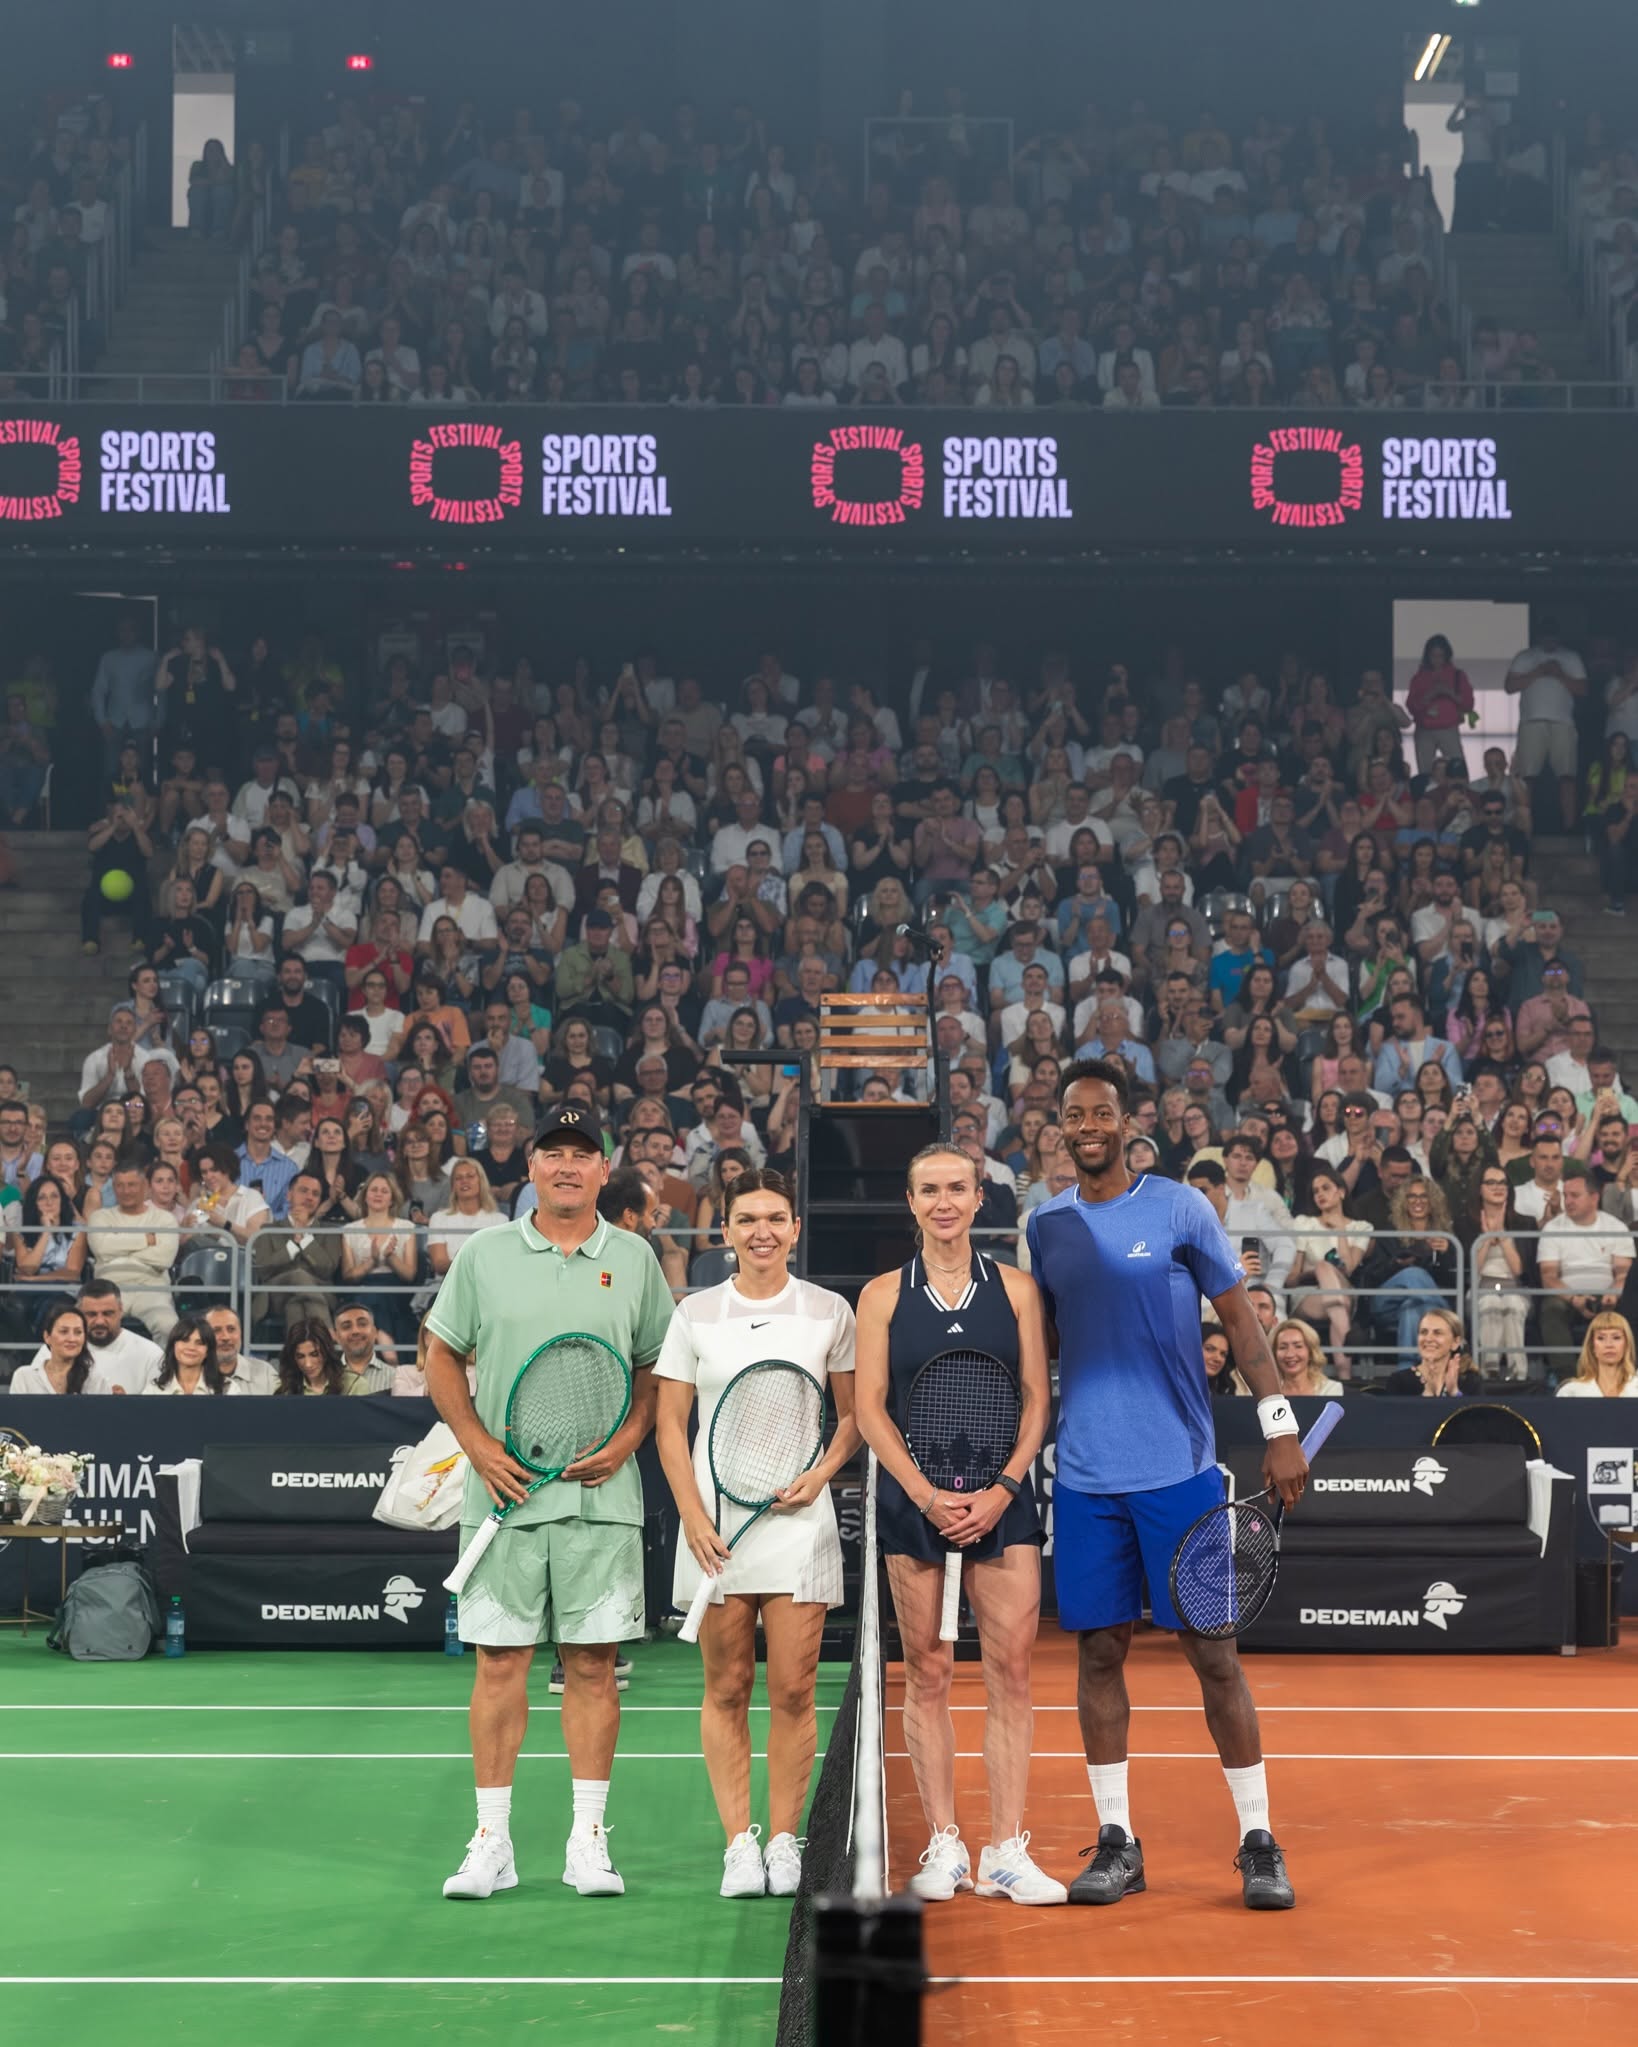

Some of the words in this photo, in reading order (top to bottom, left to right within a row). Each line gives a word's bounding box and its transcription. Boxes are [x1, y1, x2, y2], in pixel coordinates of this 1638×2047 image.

[0, 420, 60, 445] ESTIVAL
[101, 431, 215, 471] SPORTS
[428, 423, 503, 449] FESTIVAL
[830, 425, 904, 451] FESTIVAL
[1269, 427, 1343, 452] FESTIVAL
[57, 436, 81, 503] SPORTS
[409, 439, 434, 506] SPORTS
[498, 441, 523, 506] SPORTS
[542, 434, 656, 474] SPORTS
[943, 436, 1057, 476] SPORTS
[1382, 438, 1497, 477] SPORTS
[101, 472, 230, 513] FESTIVAL
[811, 442, 836, 508] SPORTS
[899, 443, 924, 509] SPORTS
[1251, 443, 1276, 509] SPORTS
[1339, 444, 1364, 510] SPORTS
[0, 495, 62, 520] FESTIVA
[430, 497, 504, 523] FESTIVAL
[542, 475, 671, 516] FESTIVAL
[832, 499, 906, 526] FESTIVAL
[943, 477, 1072, 518] FESTIVAL
[1272, 500, 1345, 527] FESTIVAL
[1382, 478, 1511, 519] FESTIVAL
[271, 1472, 386, 1488] DEDEMAN
[1313, 1478, 1411, 1493] DEDEMAN
[261, 1604, 380, 1621] DEDEMAN
[1299, 1608, 1419, 1626] DEDEMAN
